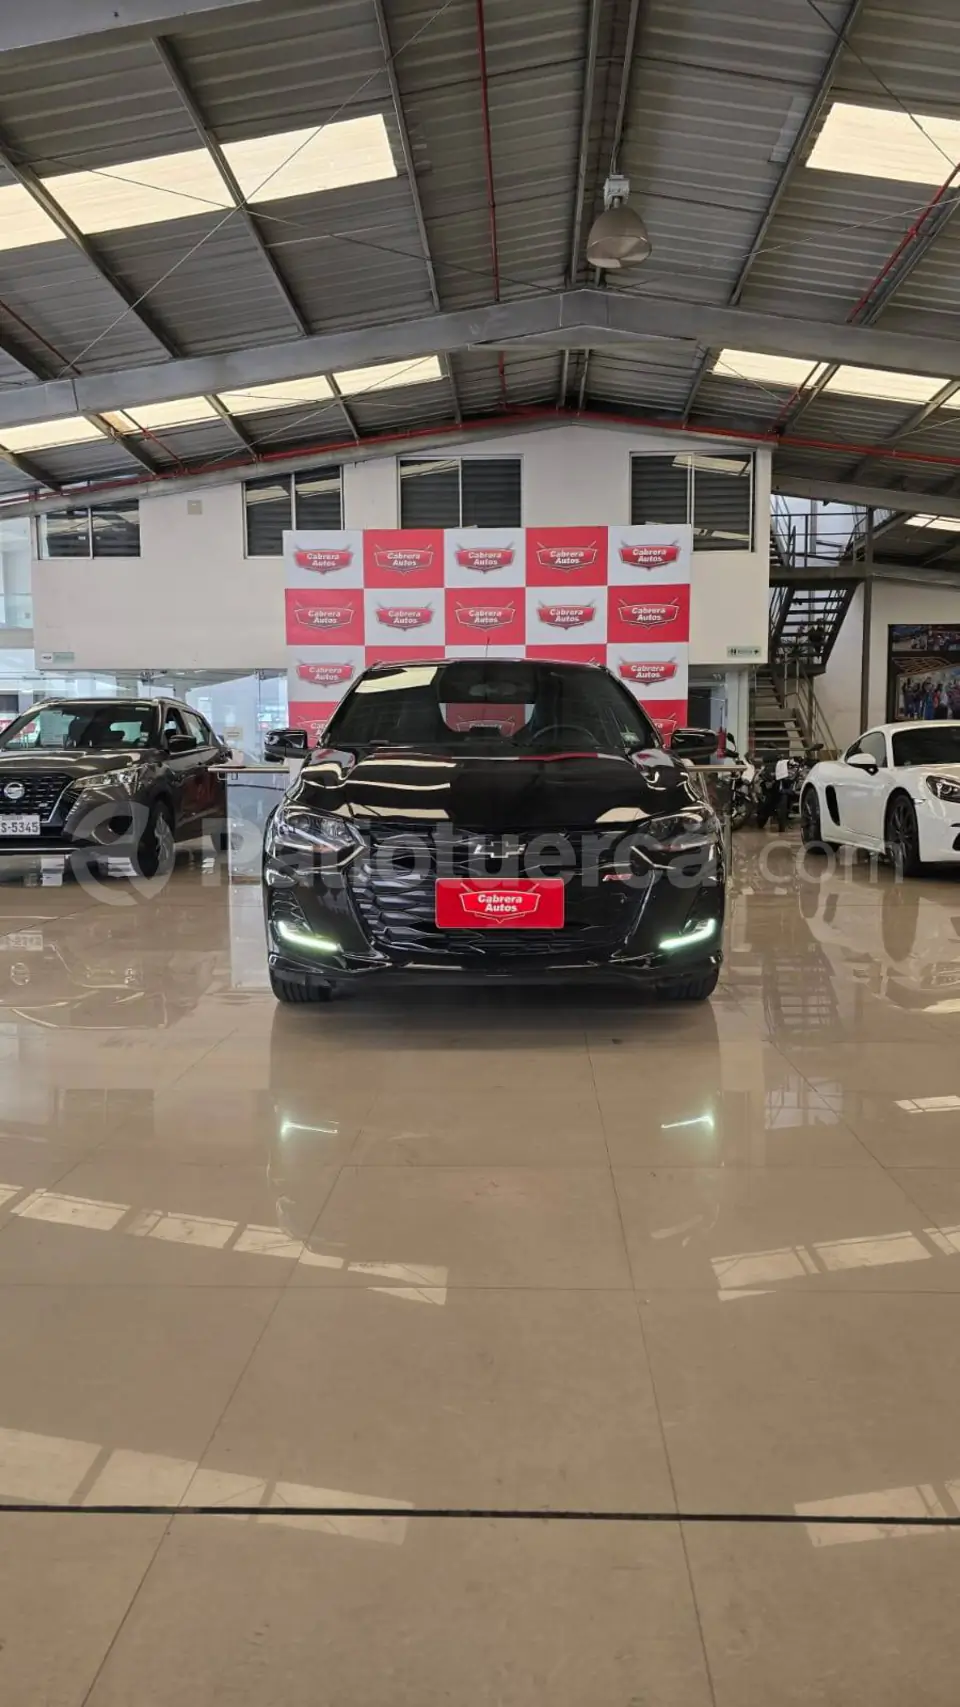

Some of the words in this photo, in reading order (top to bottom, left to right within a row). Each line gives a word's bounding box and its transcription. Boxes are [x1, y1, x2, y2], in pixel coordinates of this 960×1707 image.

[387, 552, 420, 560] Cabrera
[468, 551, 502, 559] Cabrera
[550, 550, 584, 558] Cabrera
[632, 548, 667, 556] Cabrera
[312, 559, 336, 567] Autos
[631, 607, 666, 615] Cabrera
[309, 666, 342, 674] Cabrera
[631, 664, 665, 672] Cabrera
[314, 673, 339, 681] Autos
[636, 671, 661, 679] Autos
[477, 894, 523, 903] Cabrera
[485, 903, 518, 913] Autos
